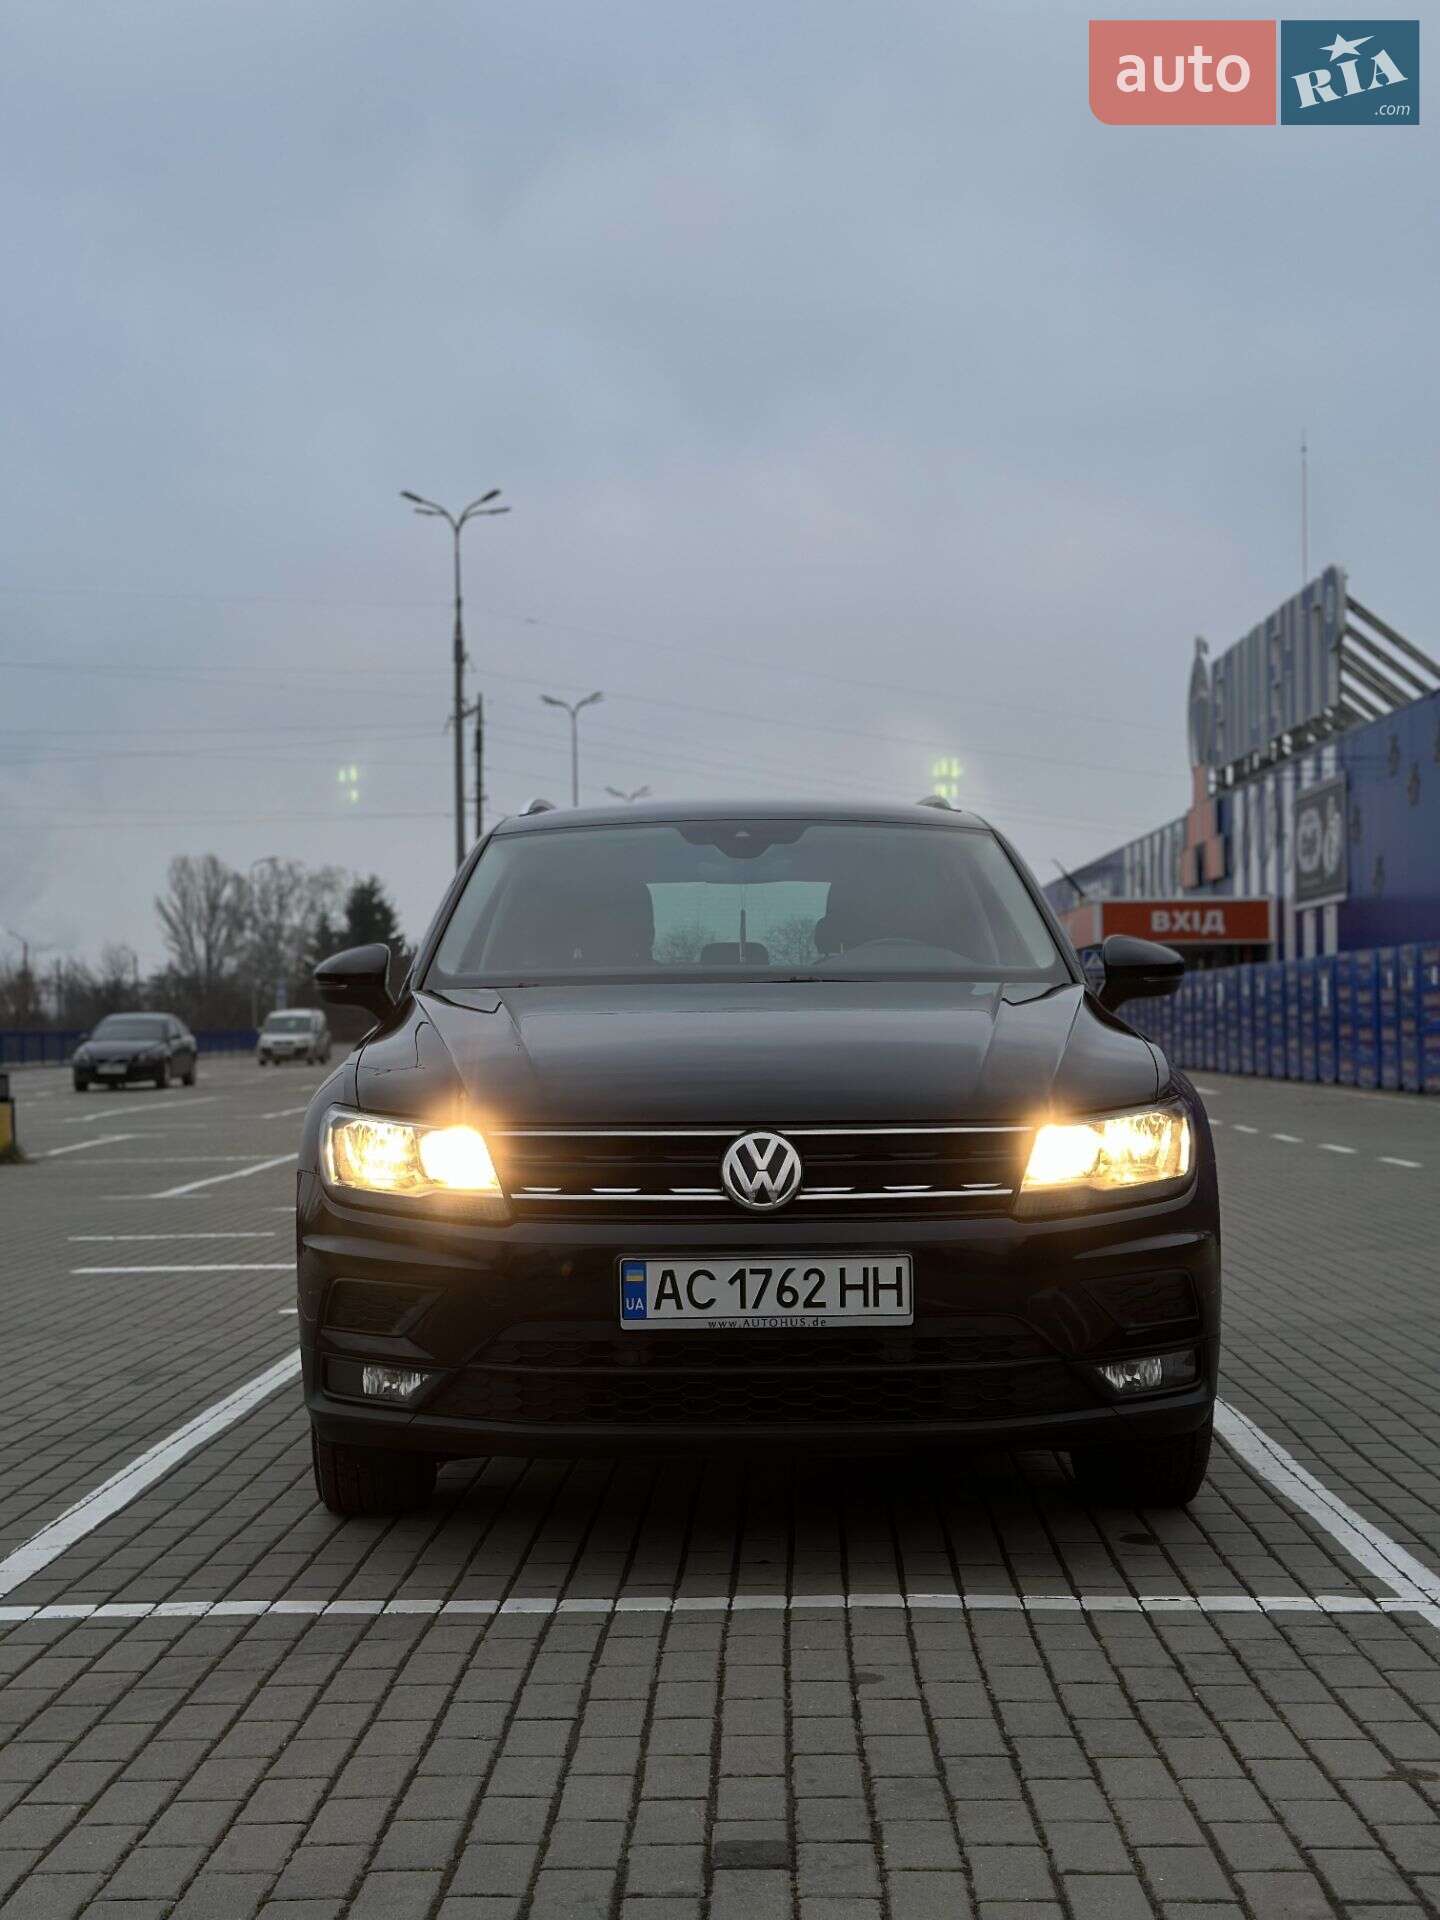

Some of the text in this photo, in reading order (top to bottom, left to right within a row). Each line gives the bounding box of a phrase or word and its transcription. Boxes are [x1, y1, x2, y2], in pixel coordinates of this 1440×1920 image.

[1151, 910, 1226, 935] ВХІД
[728, 1134, 796, 1207] VW
[727, 1268, 827, 1310] 1762
[625, 1297, 644, 1311] UA
[707, 1318, 827, 1328] www.AUTOHUS.de
